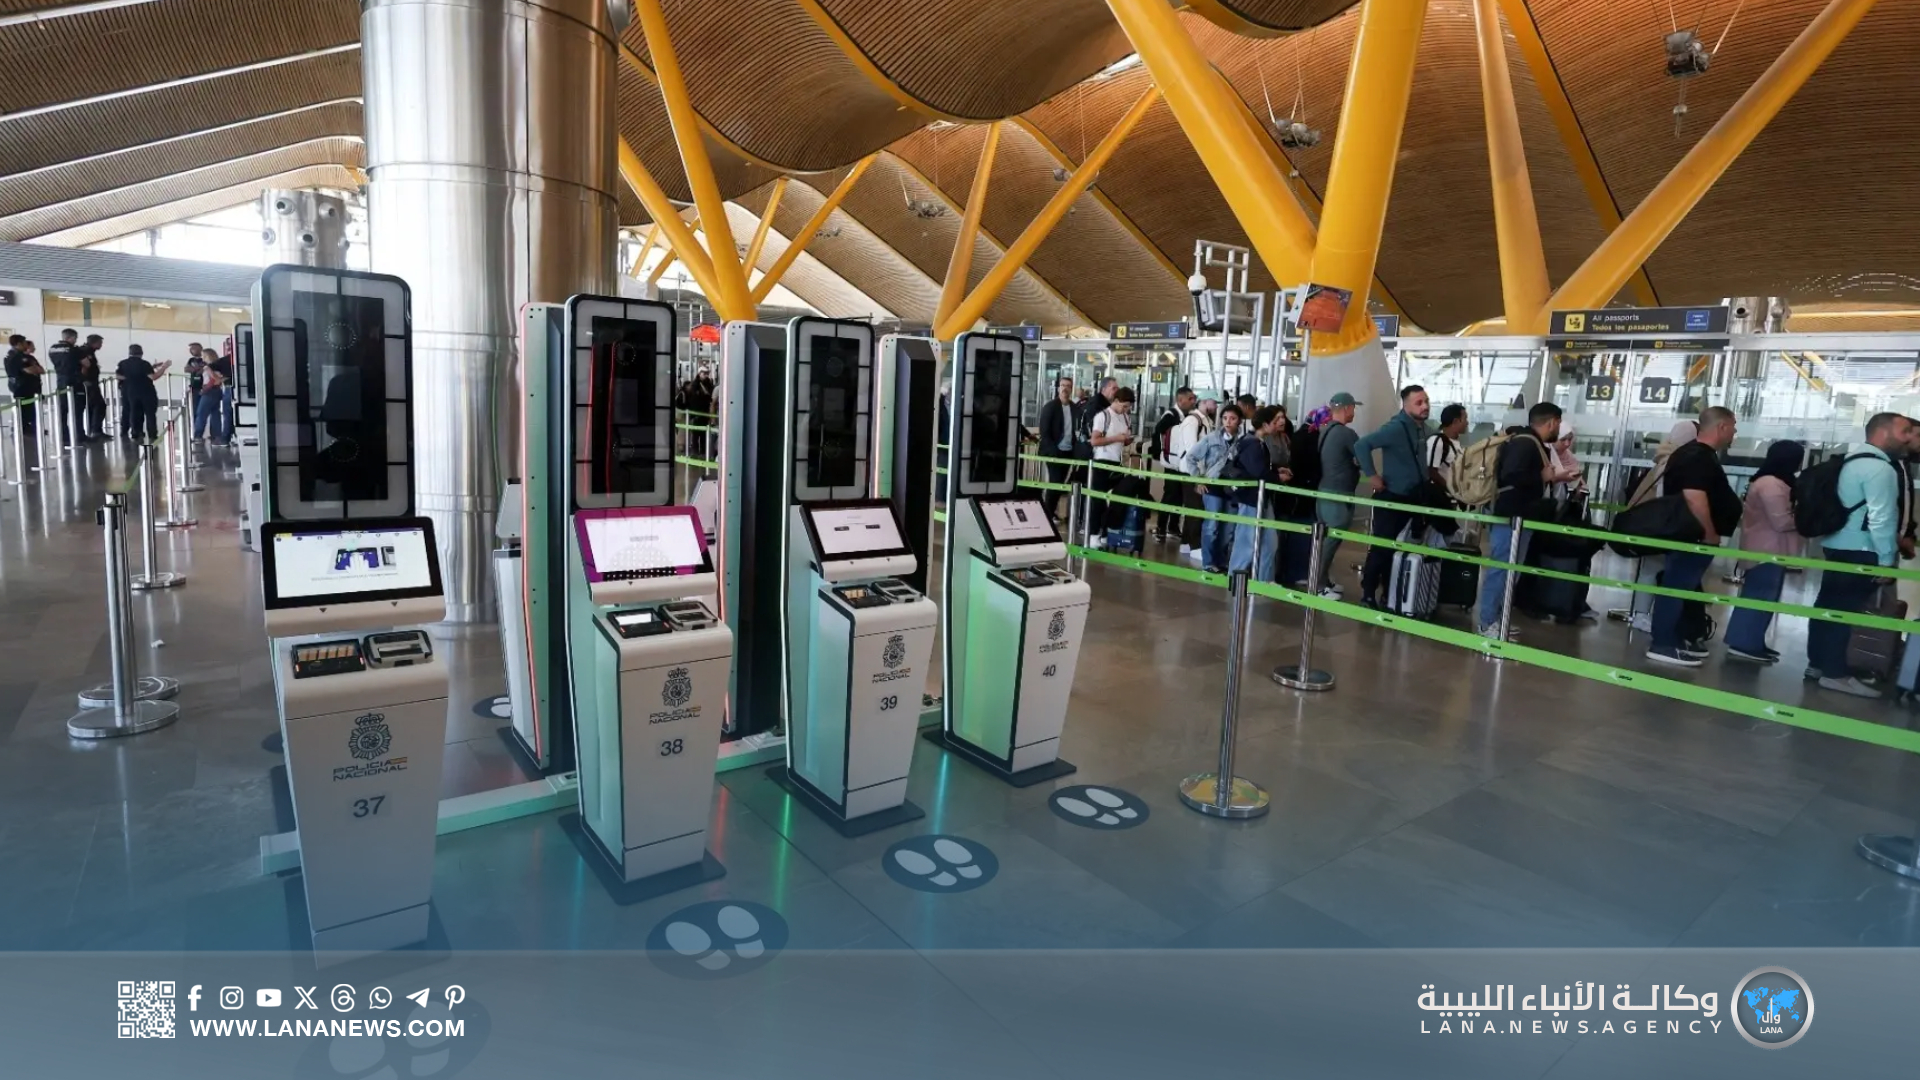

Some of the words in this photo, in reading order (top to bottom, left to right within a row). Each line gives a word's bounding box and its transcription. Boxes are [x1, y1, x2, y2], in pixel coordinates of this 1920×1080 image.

[1604, 314, 1640, 322] passports
[1627, 323, 1670, 332] pasaportes
[1152, 372, 1162, 381] 10
[1590, 384, 1611, 398] 13
[1644, 386, 1666, 400] 14
[1042, 664, 1056, 678] 40
[880, 695, 898, 711] 39
[660, 738, 683, 757] 38
[333, 759, 392, 775] POLICIA
[333, 764, 407, 782] NACIONAL
[353, 795, 386, 818] 37
